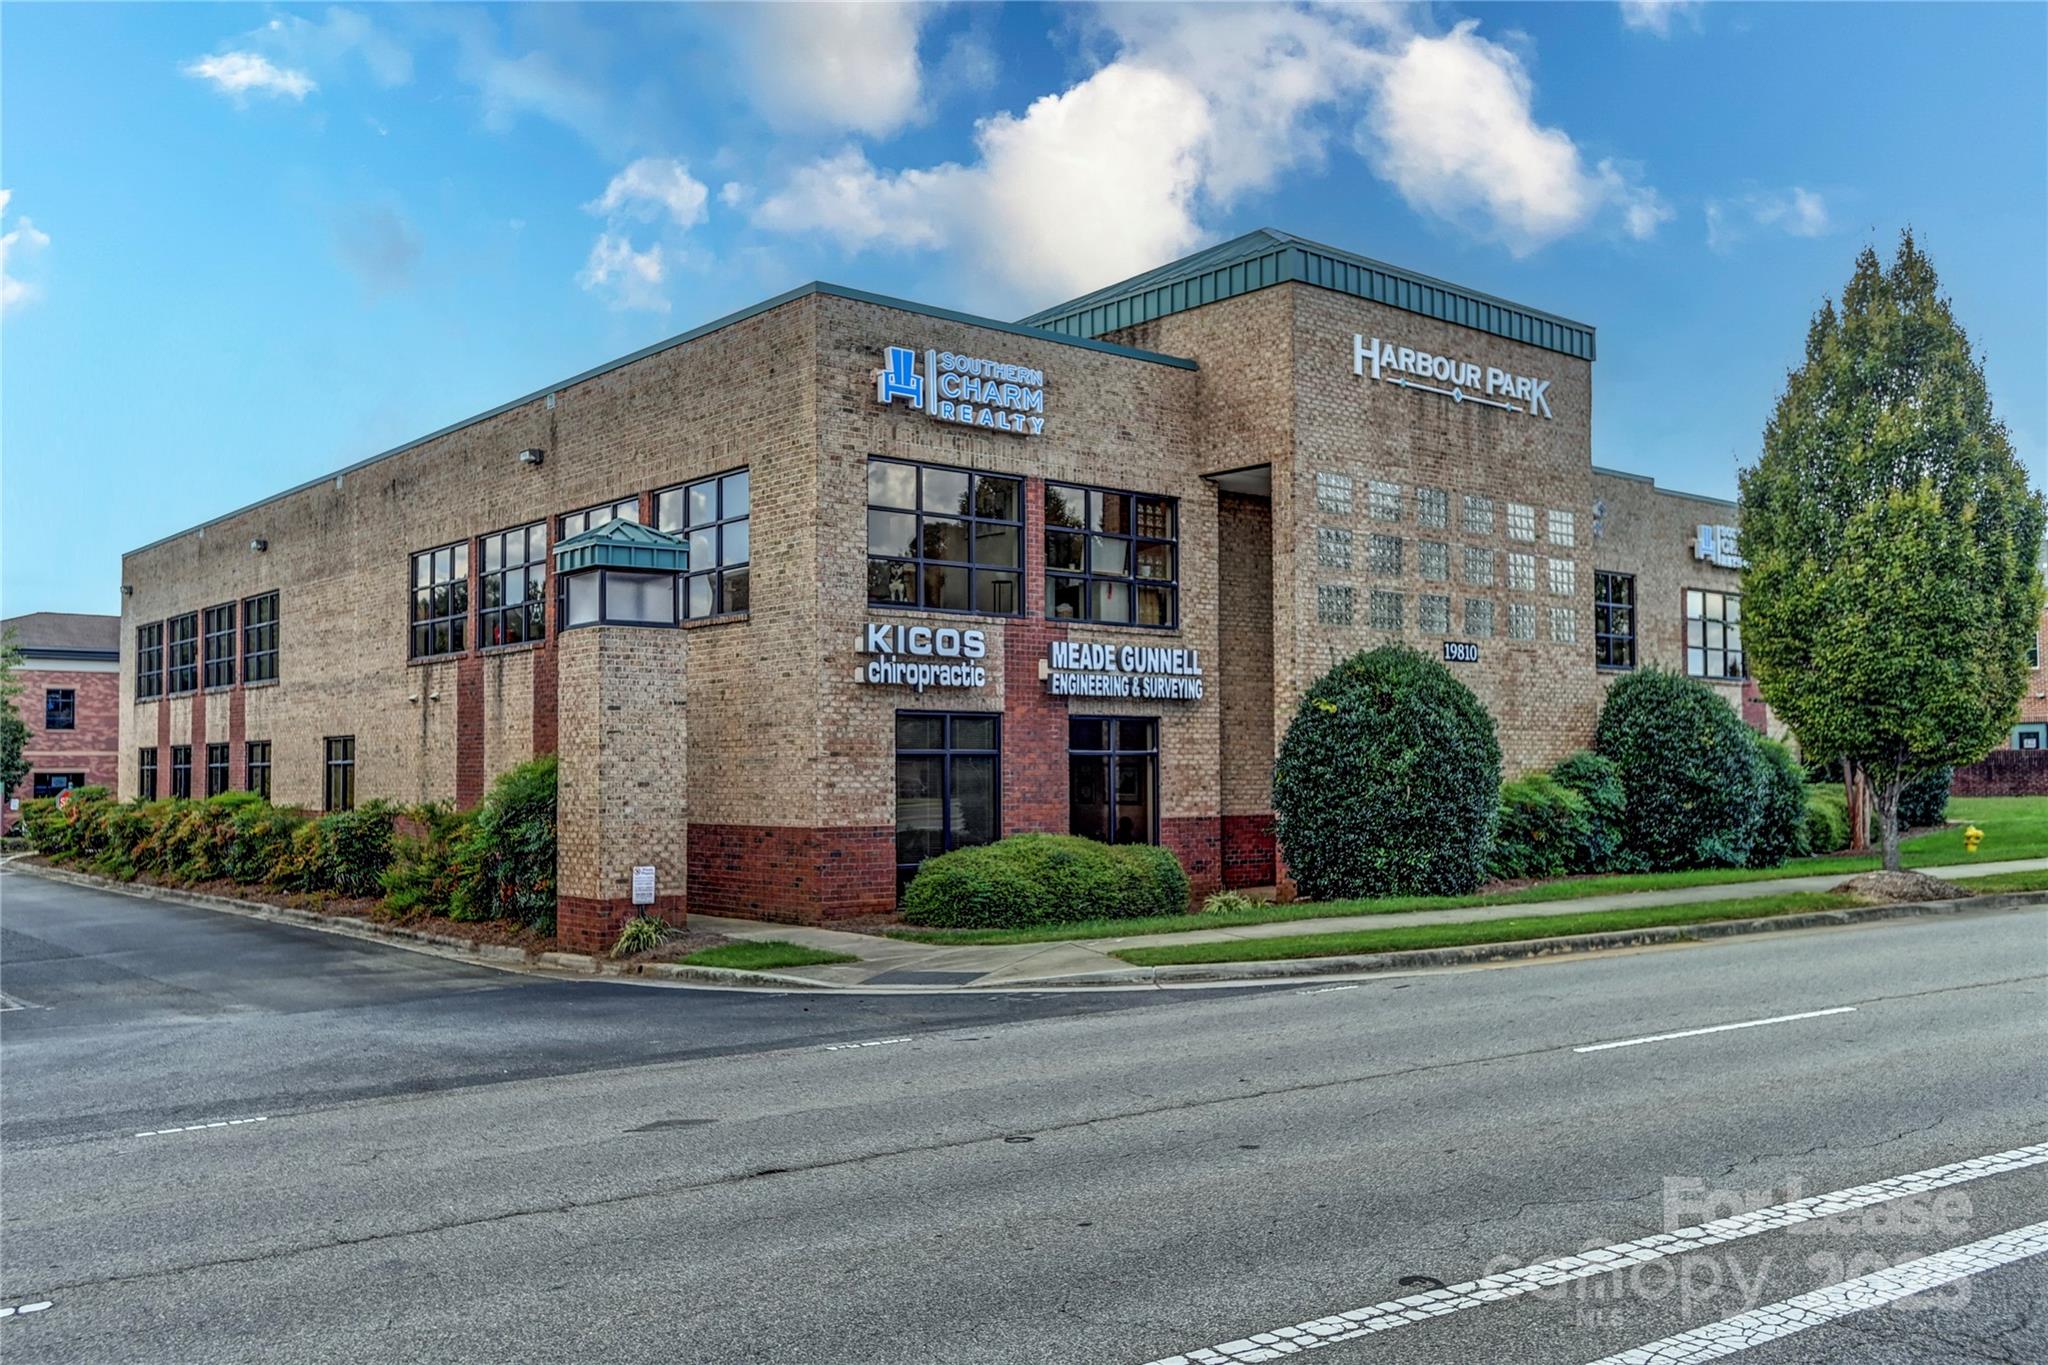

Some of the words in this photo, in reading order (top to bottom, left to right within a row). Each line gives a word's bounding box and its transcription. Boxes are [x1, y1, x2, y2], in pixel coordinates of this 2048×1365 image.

[941, 351, 1043, 387] SOUTHERN
[1353, 334, 1481, 390] HARBOUR
[1487, 366, 1552, 419] PARK
[940, 372, 1043, 414] CHARM
[942, 400, 1044, 435] REALTY
[867, 623, 985, 658] KICOS
[1052, 641, 1115, 670] MEADE
[1121, 645, 1202, 675] GUNNELL
[1444, 643, 1477, 661] 19810
[868, 654, 986, 693] chiropractic
[1052, 673, 1129, 697] ENGINEERING
[1131, 676, 1140, 698] &
[1142, 677, 1203, 699] SURVEYING
